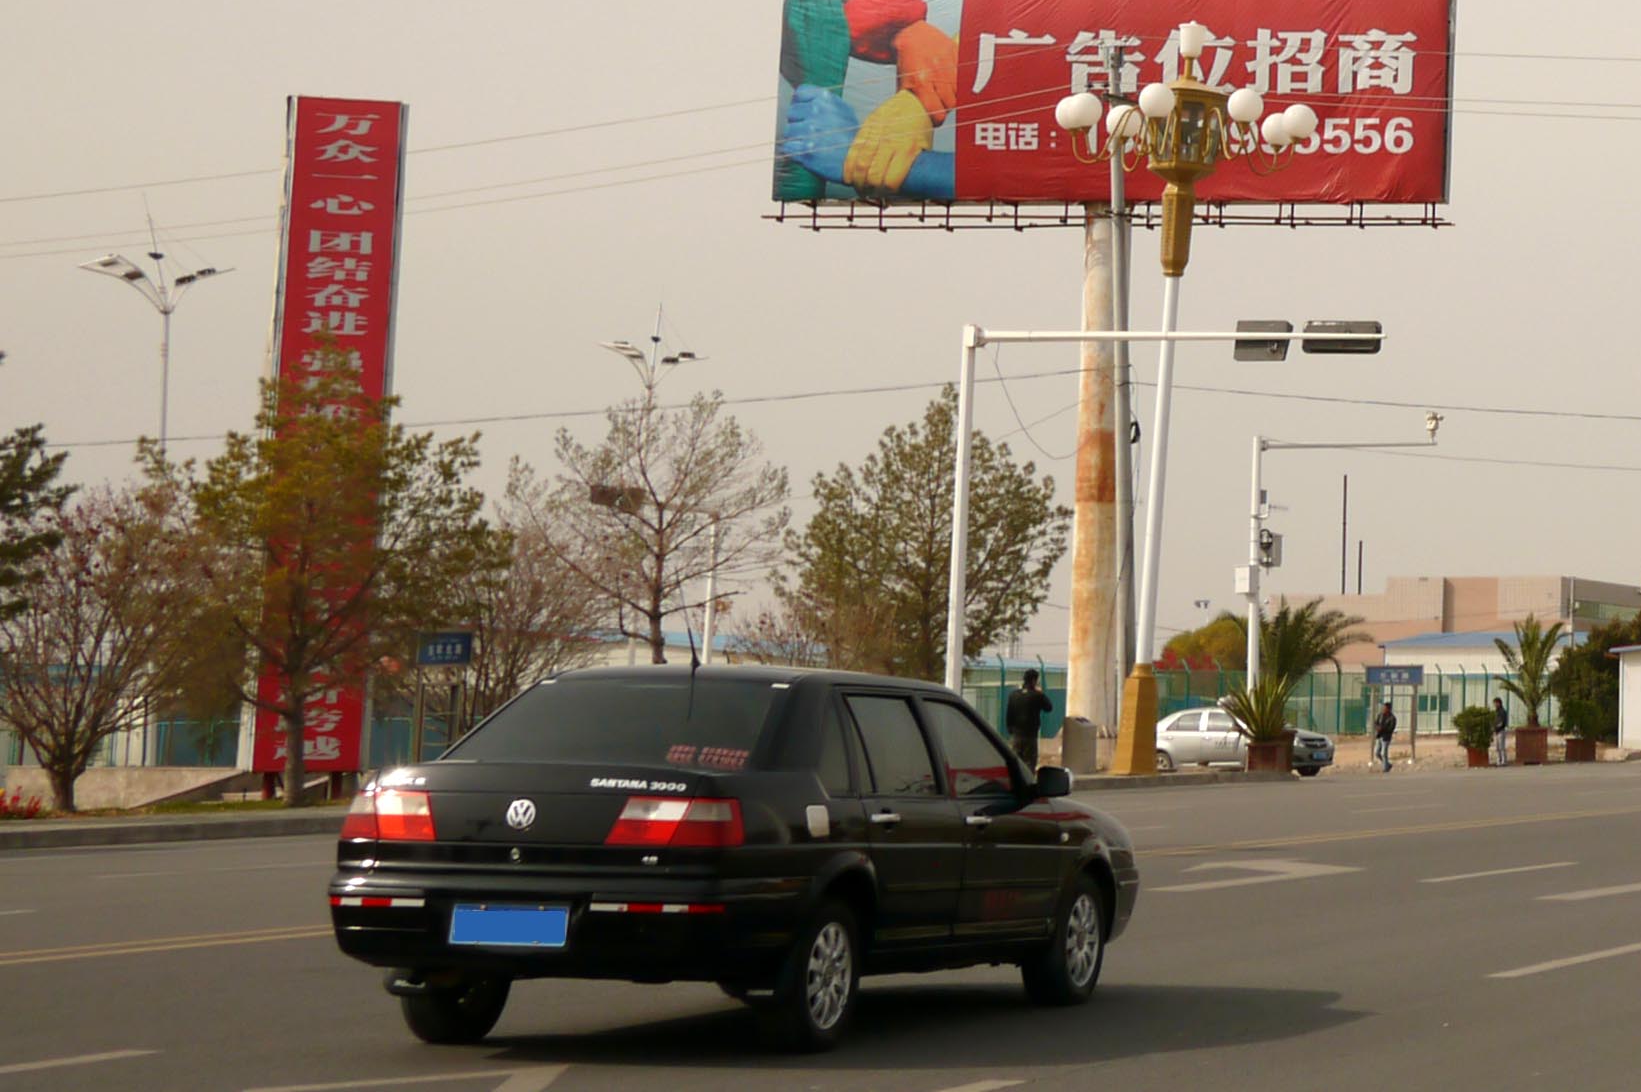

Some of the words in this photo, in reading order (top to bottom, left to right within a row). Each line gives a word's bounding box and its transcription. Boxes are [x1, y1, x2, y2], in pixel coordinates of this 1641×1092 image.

[972, 28, 1418, 96] 广告位招商
[590, 777, 648, 790] SANTANA
[650, 780, 687, 792] 3000
